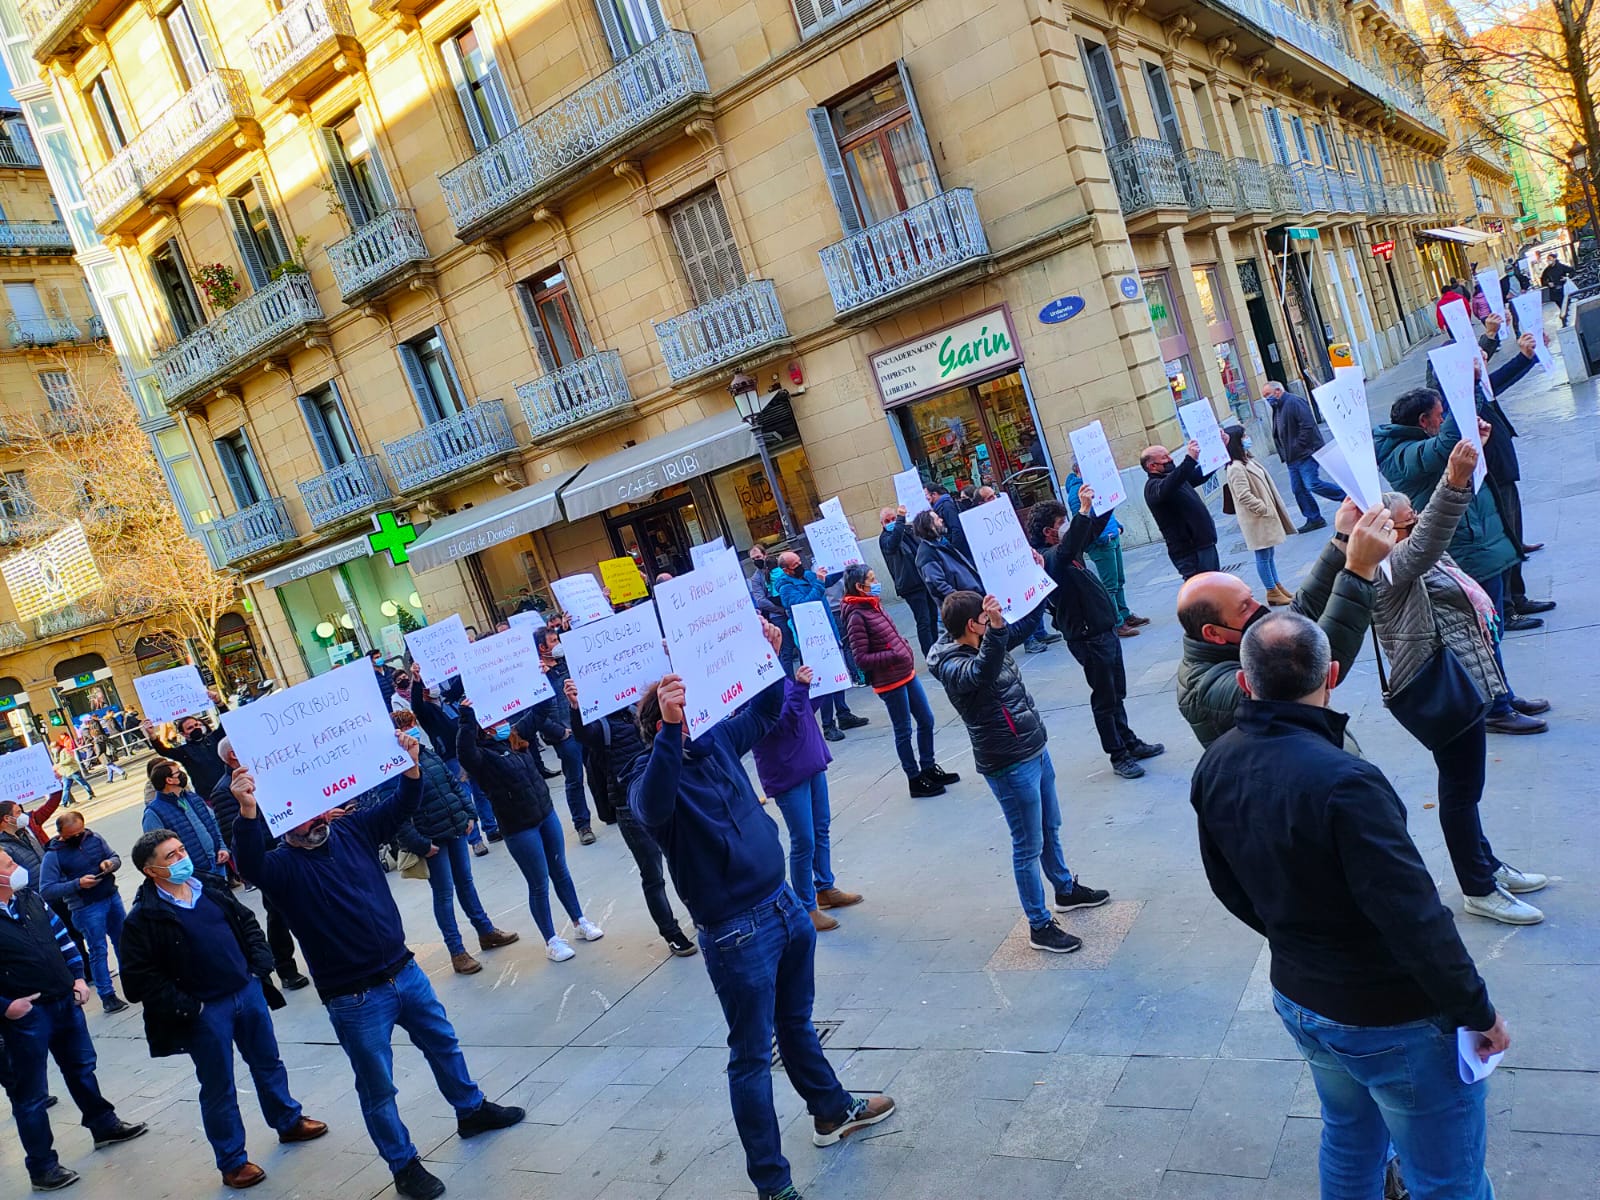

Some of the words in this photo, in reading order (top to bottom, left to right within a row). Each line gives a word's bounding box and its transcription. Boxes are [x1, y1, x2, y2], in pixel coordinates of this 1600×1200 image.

[1049, 305, 1073, 317] Urdaneta
[938, 326, 1011, 378] Garín
[880, 365, 917, 383] IMPRENTA
[448, 544, 457, 558] El
[477, 534, 485, 546] de
[486, 521, 516, 543] Donosti
[298, 559, 325, 576] CAMINO
[670, 592, 686, 610] EL
[671, 628, 684, 643] LA
[577, 658, 609, 679] KATEEK
[613, 641, 655, 662] KATEATZEN
[614, 685, 637, 701] UAGN
[721, 680, 744, 705] UAGN
[259, 687, 351, 737] DISTRIBUZIO
[502, 698, 521, 712] UAGN
[251, 742, 307, 775] KATEEK
[311, 712, 372, 749] KATEATZEN
[322, 773, 357, 797] UAGN
